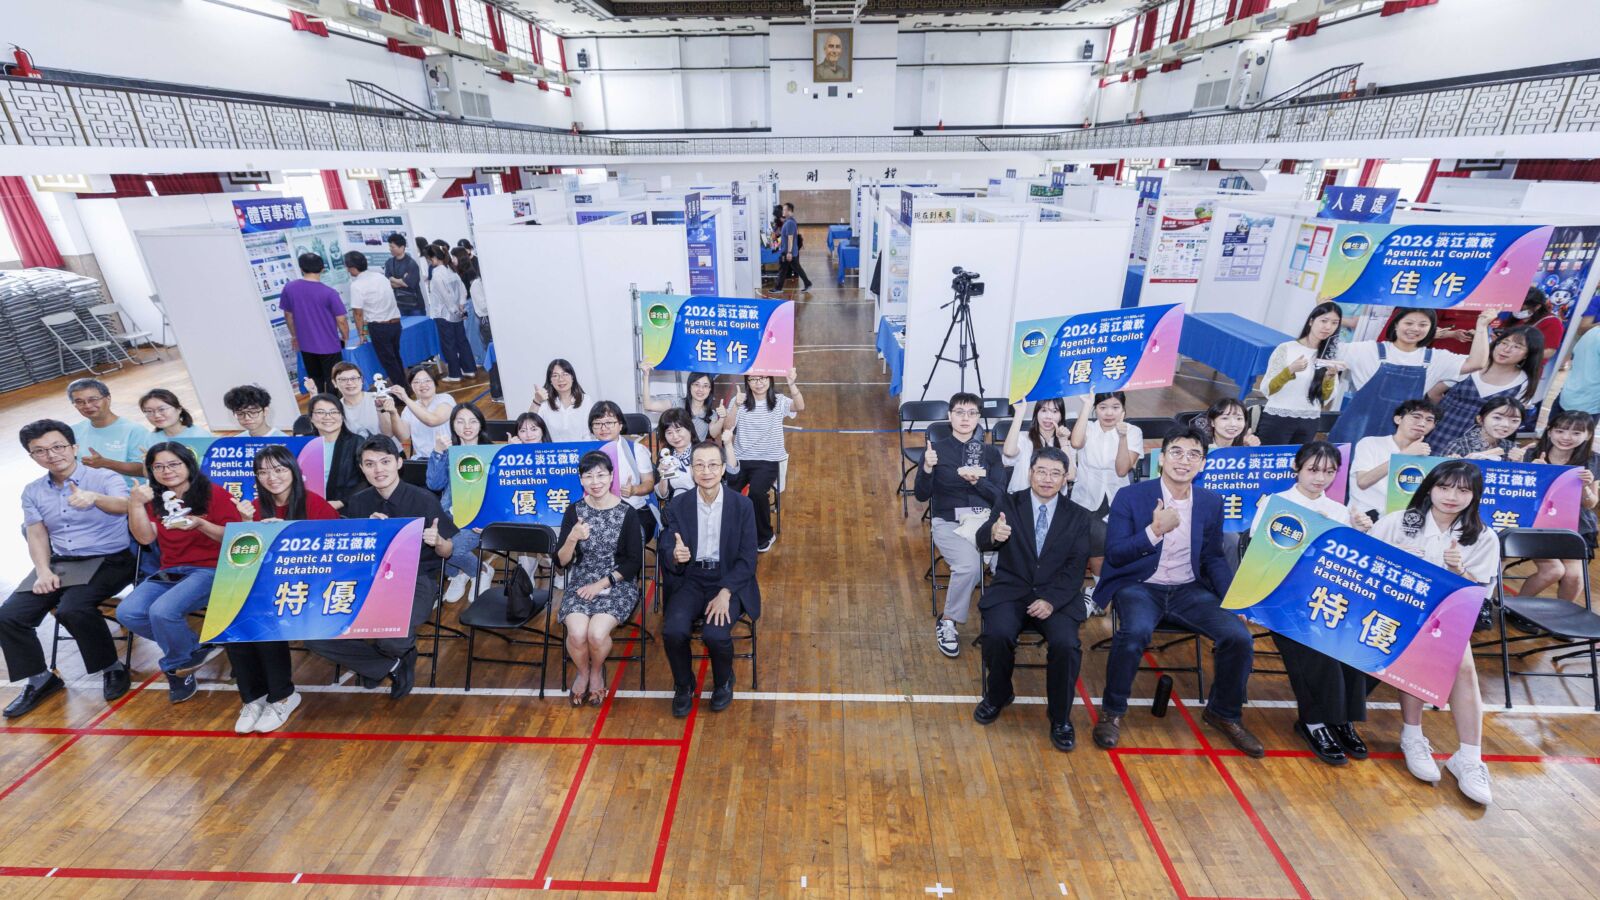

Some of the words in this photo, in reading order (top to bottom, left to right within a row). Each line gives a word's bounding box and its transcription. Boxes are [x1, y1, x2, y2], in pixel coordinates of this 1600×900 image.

[1331, 192, 1387, 214] 人資處
[246, 203, 306, 225] 體育事務處
[1389, 235, 1433, 248] 2026
[1435, 236, 1495, 249] 淡江微軟
[1385, 249, 1428, 259] Agentic
[1431, 250, 1445, 258] AI
[1449, 251, 1492, 261] Copilot
[1383, 258, 1443, 267] Hackathon
[1390, 270, 1466, 298] 佳作
[684, 305, 716, 317] 2026
[717, 307, 759, 320] 淡江微軟
[684, 319, 716, 328] Agentic
[730, 321, 760, 330] Copilot
[684, 327, 728, 336] Hackathon
[1062, 324, 1098, 338] 2026
[1099, 318, 1145, 334] 淡江微軟
[1060, 337, 1096, 349] Agentic
[1097, 335, 1109, 344] AI
[1111, 332, 1144, 344] Copilot
[695, 339, 748, 364] 佳作
[1059, 345, 1108, 358] Hackathon
[1068, 355, 1128, 386] 優等
[211, 447, 243, 458] 2026
[498, 454, 533, 466] 2026
[535, 453, 580, 465] 淡江微軟
[210, 460, 243, 469] Agentic
[1206, 458, 1246, 470] 2026
[498, 469, 533, 477] Agentic
[1204, 472, 1244, 481] Agentic
[1263, 471, 1298, 480] Copilo
[1485, 473, 1537, 487] 淡江微軟
[1204, 481, 1260, 490] Hackathon
[1484, 487, 1496, 495] AI
[1499, 488, 1537, 499] Copilot
[511, 488, 571, 515] 優等
[1492, 510, 1520, 531] 等
[1271, 521, 1304, 542] 學生組
[231, 544, 258, 554] 綜合組
[279, 537, 321, 551] 2026
[323, 537, 377, 550] 淡江微軟
[276, 554, 318, 565] Agentic
[320, 554, 333, 563] AI
[336, 553, 376, 564] Copilot
[274, 565, 332, 575] Hackathon
[1323, 539, 1370, 570] 2026
[1372, 561, 1431, 598] 淡江微軟
[1313, 566, 1377, 601] Hackathon
[1317, 555, 1363, 581] Agentic
[1364, 576, 1380, 589] AI
[1382, 584, 1426, 610] Copilot
[274, 580, 358, 617] 特優
[1309, 586, 1401, 655] 特優
